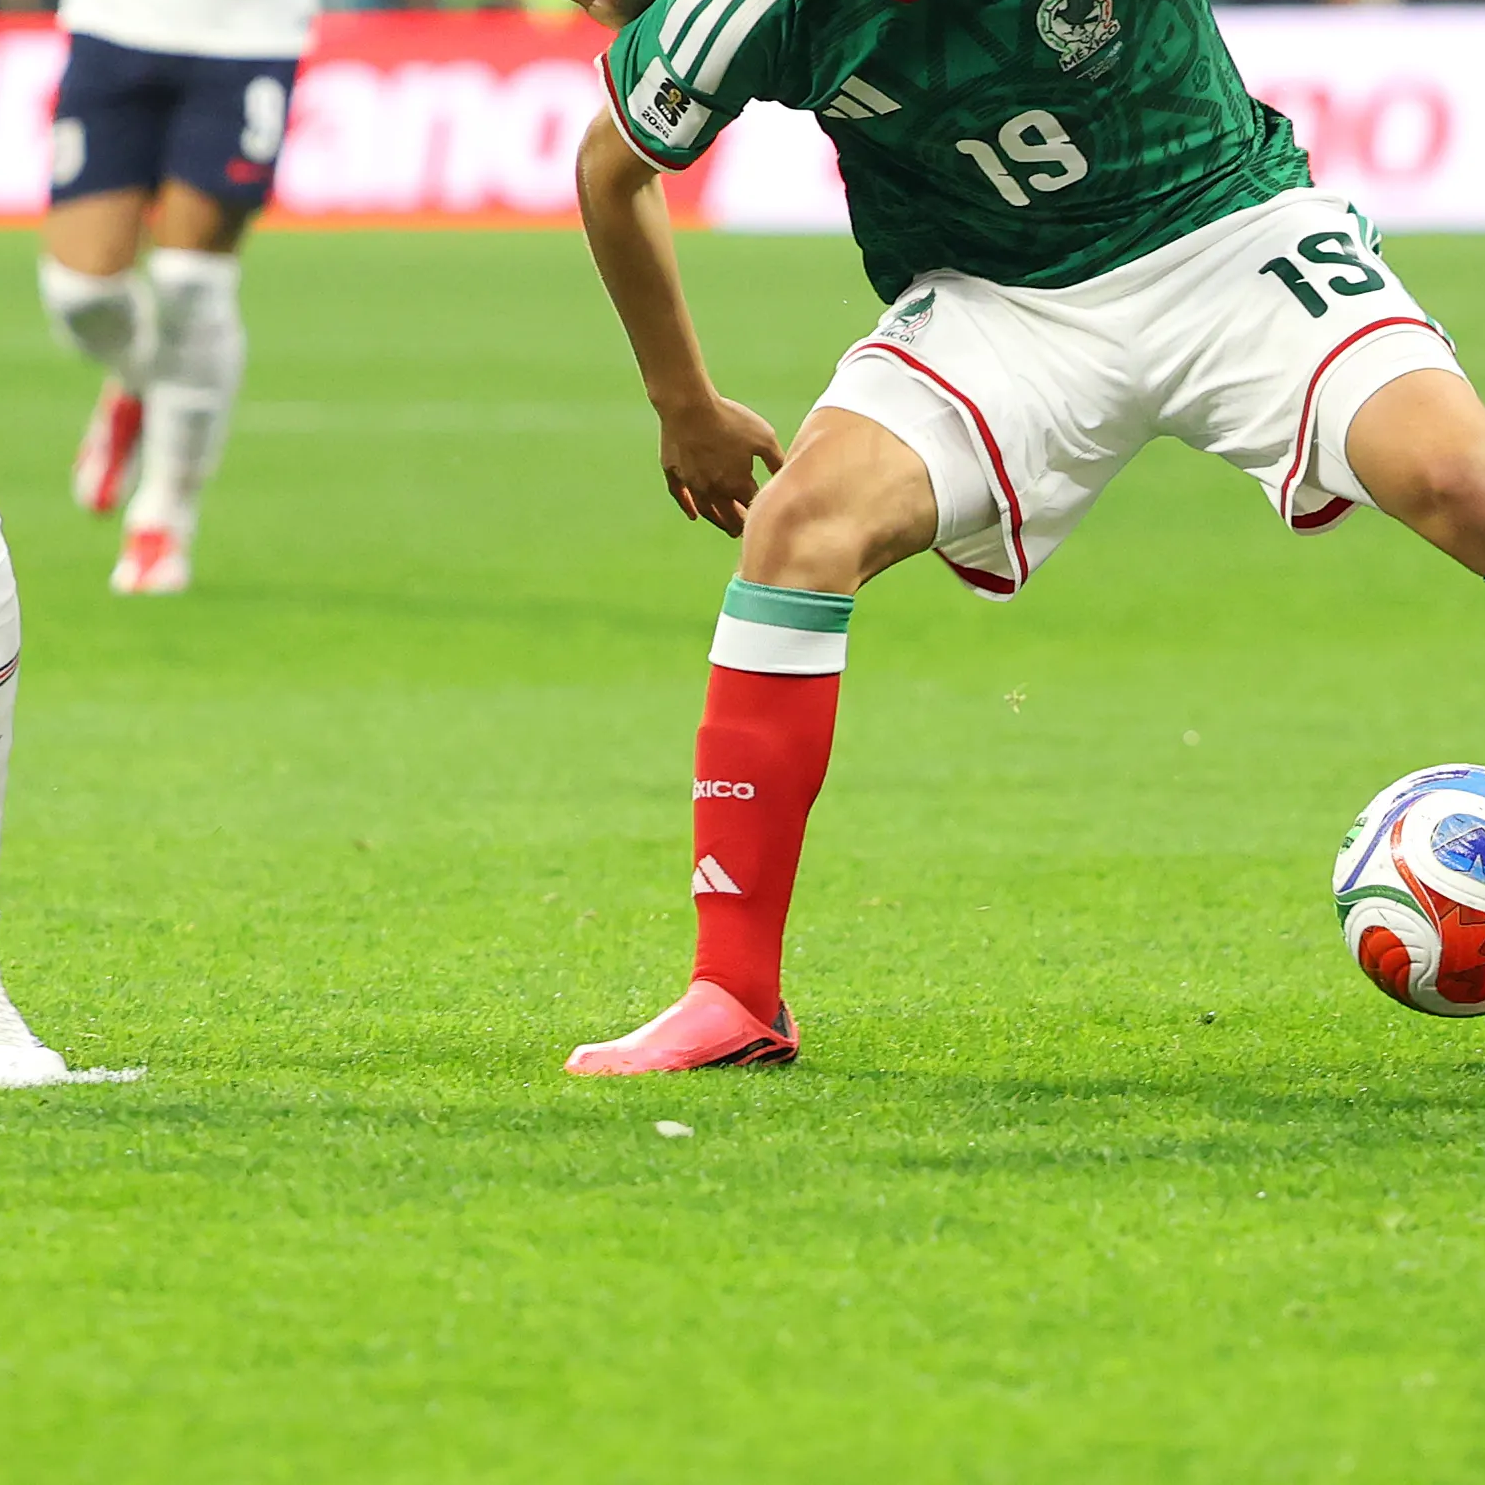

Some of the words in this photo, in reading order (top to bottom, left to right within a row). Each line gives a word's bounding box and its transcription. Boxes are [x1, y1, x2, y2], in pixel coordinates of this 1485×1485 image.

[240, 74, 297, 163] 9
[641, 110, 670, 139] 2026
[955, 109, 1089, 208] 19
[1258, 231, 1386, 318] 19
